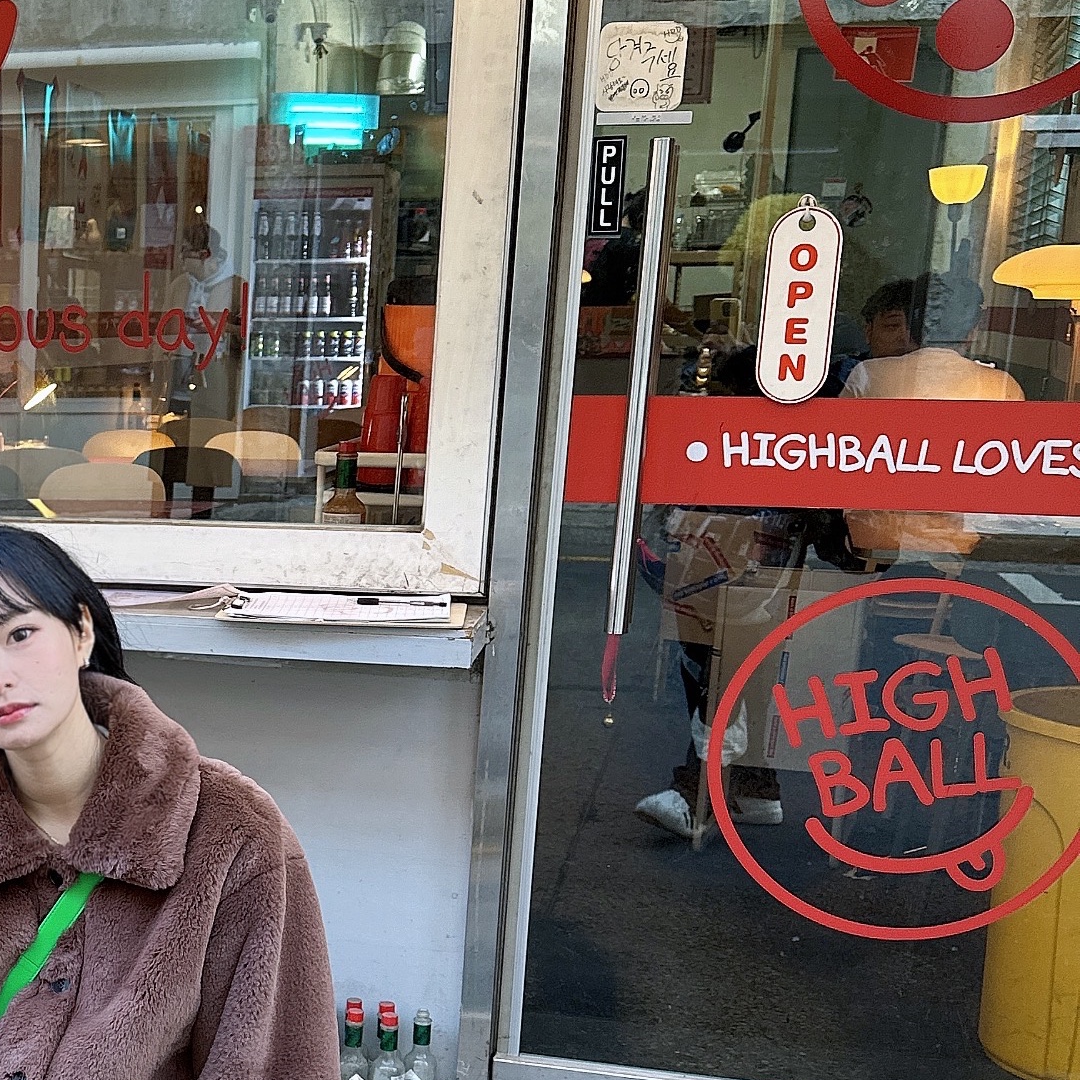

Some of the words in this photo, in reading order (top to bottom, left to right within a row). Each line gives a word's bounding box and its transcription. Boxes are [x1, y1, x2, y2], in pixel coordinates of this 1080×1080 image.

[599, 144, 617, 228] PULL
[117, 270, 249, 371] day!
[777, 243, 818, 382] OPEN
[721, 431, 942, 474] HIGHBALL
[772, 646, 1013, 748] HIGH
[807, 732, 1022, 817] BALL
